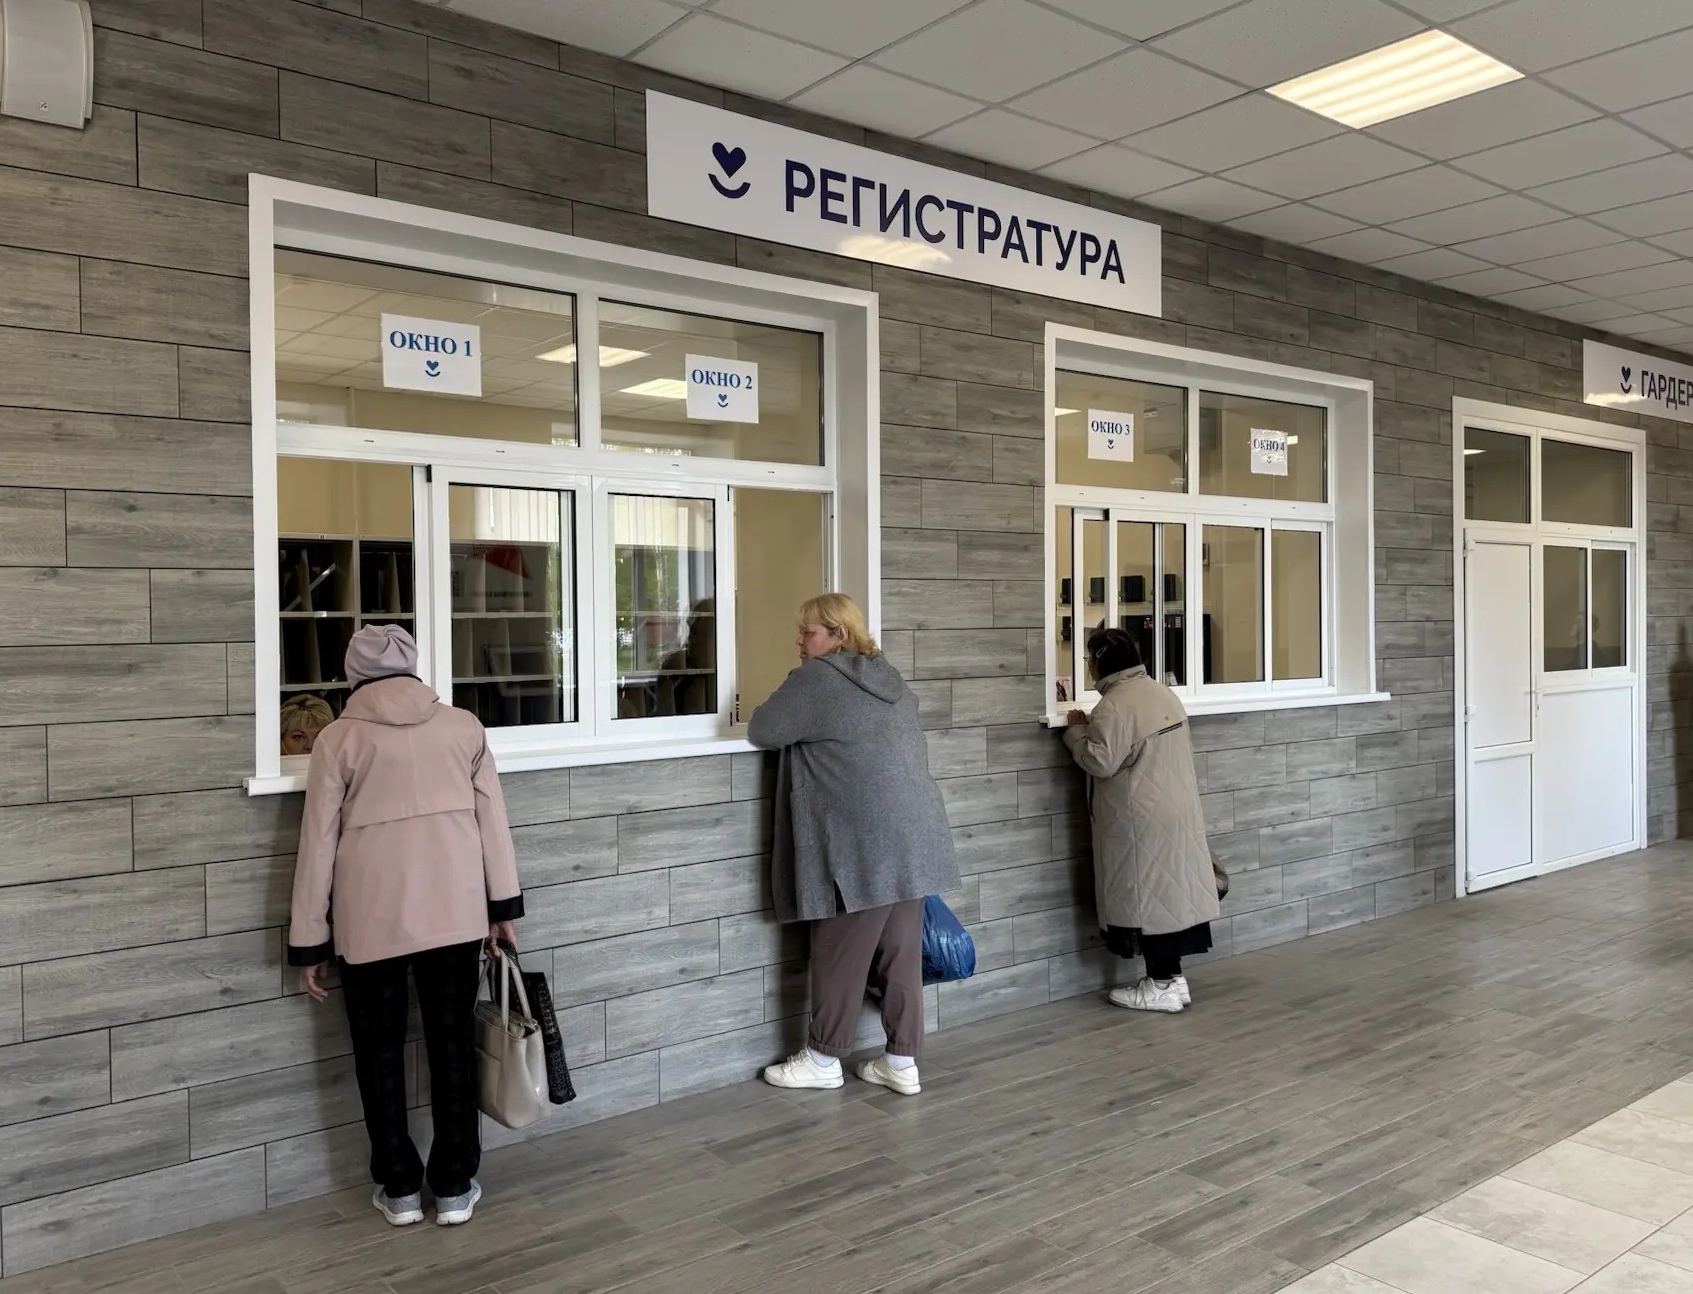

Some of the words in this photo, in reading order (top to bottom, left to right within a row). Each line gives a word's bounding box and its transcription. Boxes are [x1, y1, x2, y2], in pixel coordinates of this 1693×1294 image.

[785, 159, 1126, 285] РЕГИСТРАТУРА
[389, 330, 457, 355] ОКНО
[464, 340, 472, 357] 1
[691, 369, 741, 389] ОКНО
[745, 375, 752, 390] 2
[1091, 420, 1123, 435] ОКНО
[1125, 424, 1130, 436] 3
[1253, 438, 1279, 452] ОКНО
[1280, 441, 1285, 452] 4
